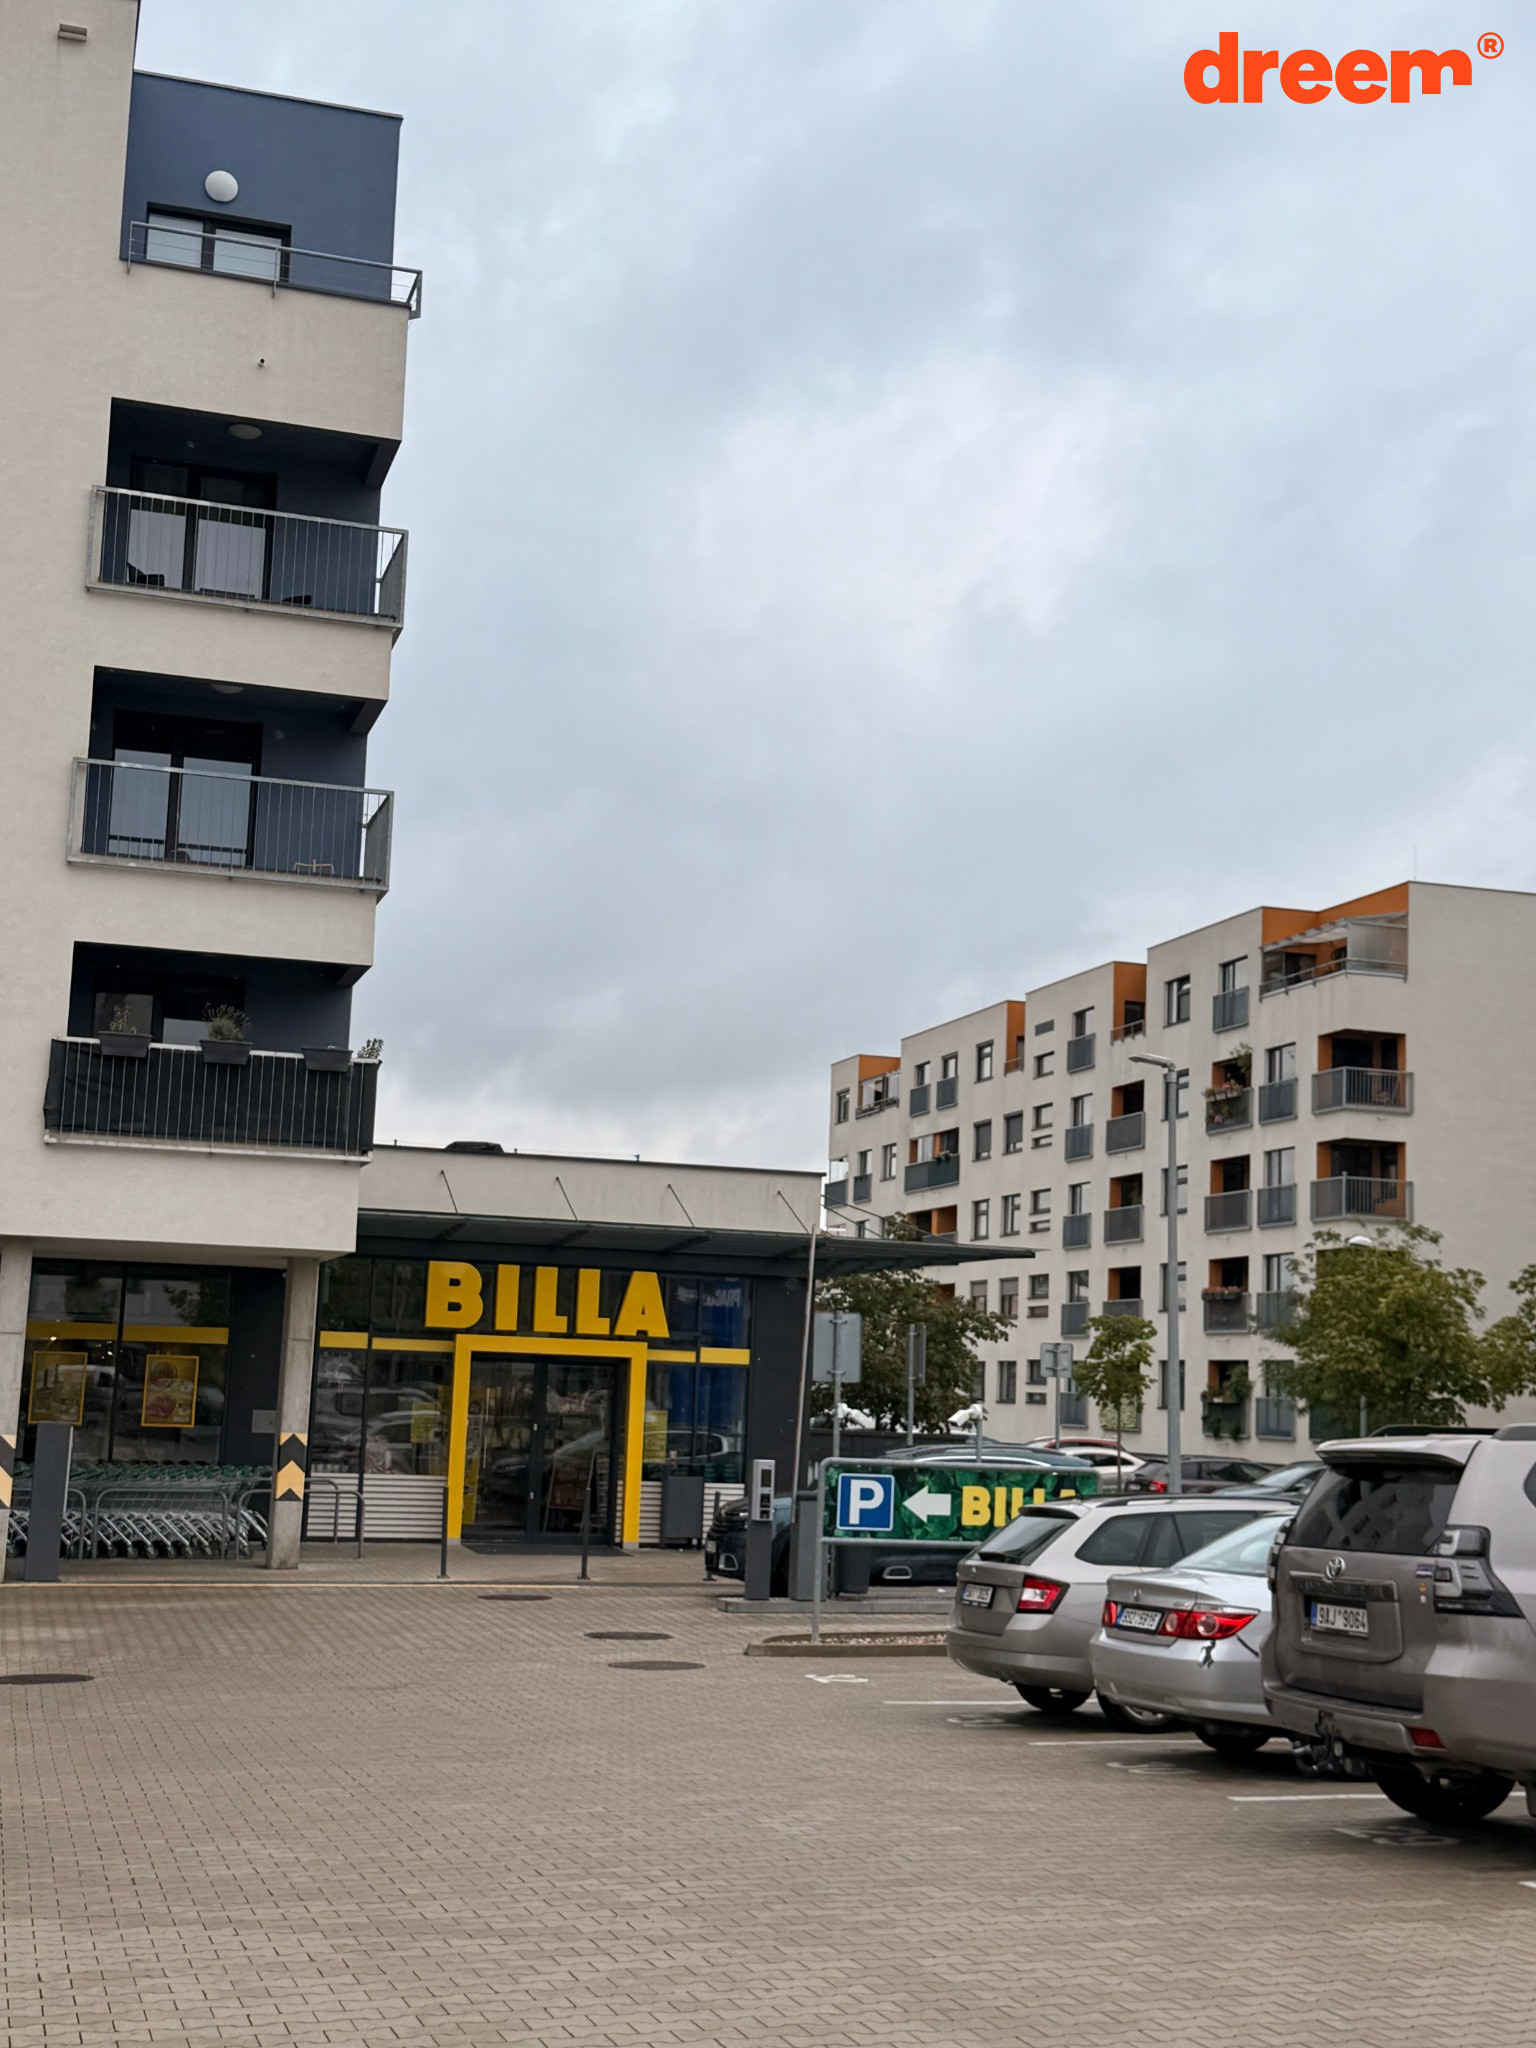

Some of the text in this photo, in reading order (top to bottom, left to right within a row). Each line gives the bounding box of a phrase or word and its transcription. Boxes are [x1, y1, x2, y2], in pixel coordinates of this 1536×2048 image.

[425, 1260, 670, 1338] BILLA
[848, 1479, 1076, 1527] P BIL
[1343, 1609, 1366, 1631] 9064
